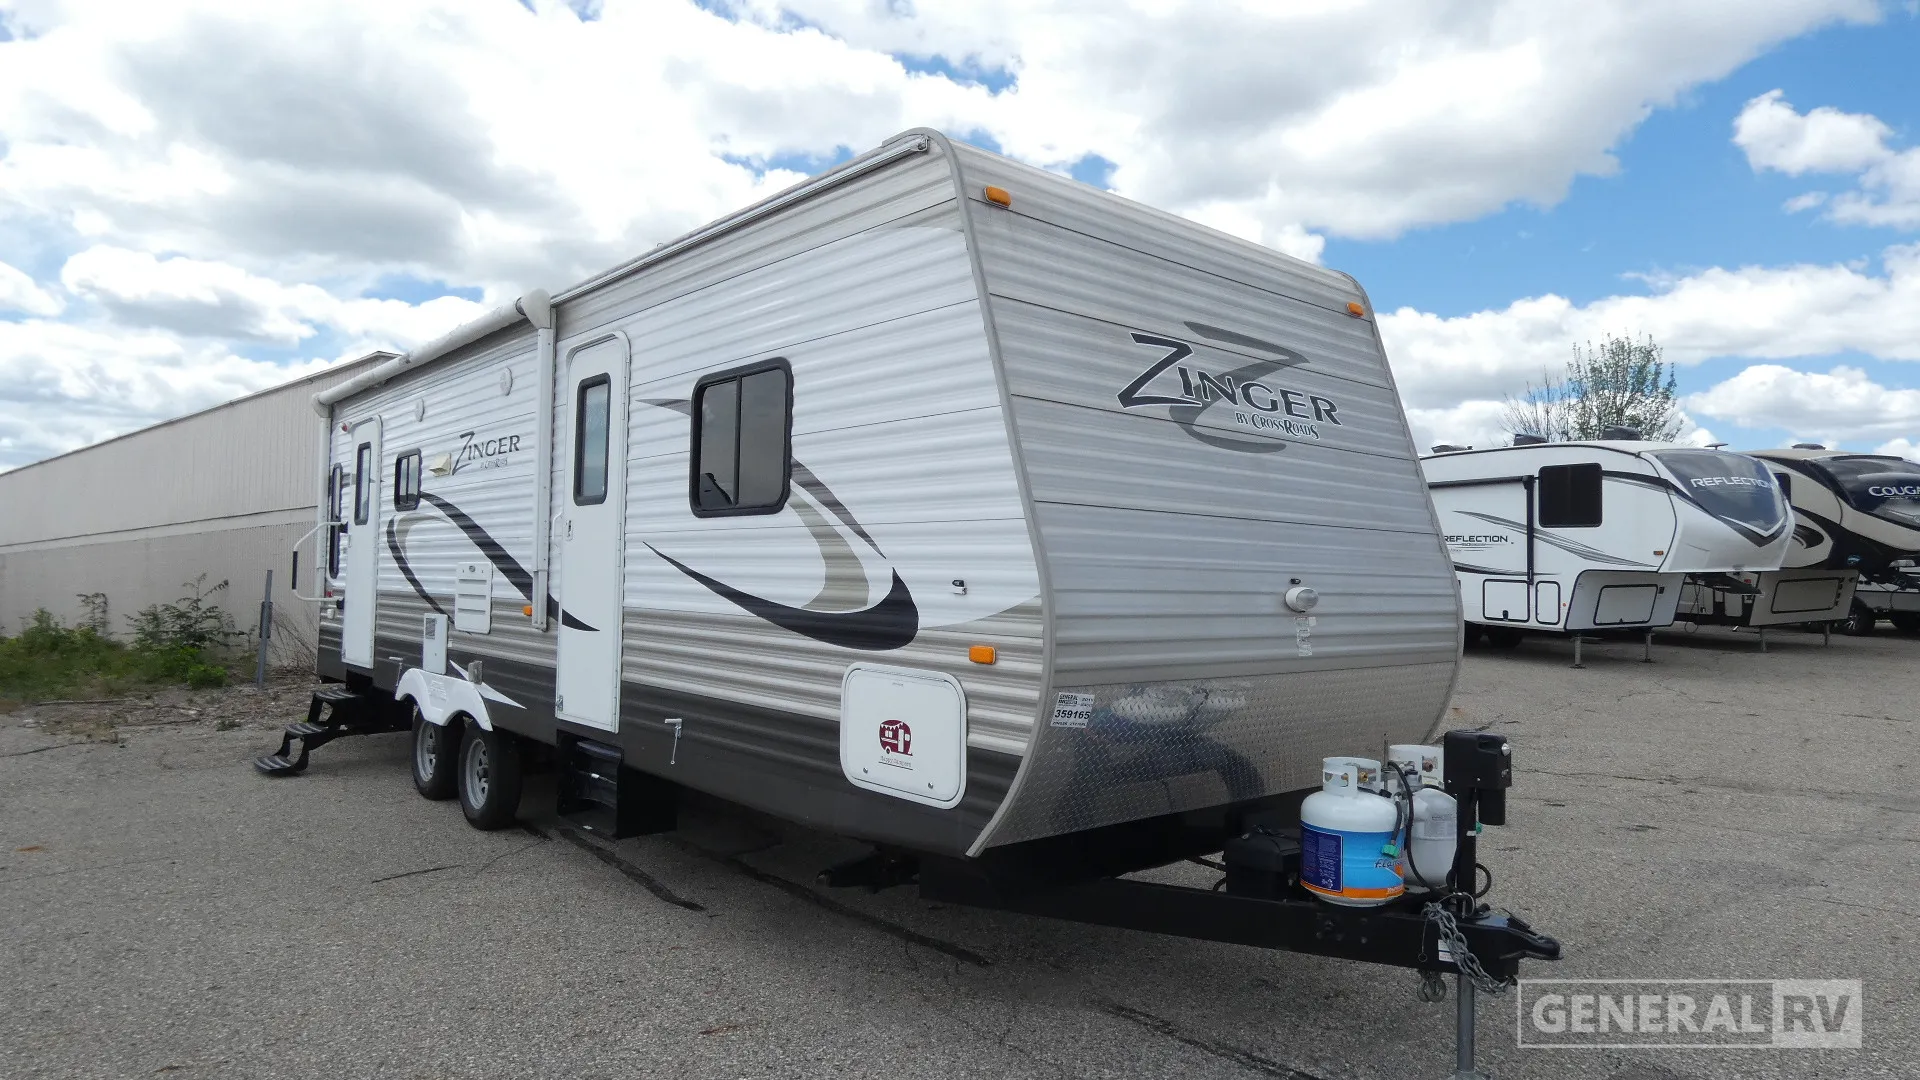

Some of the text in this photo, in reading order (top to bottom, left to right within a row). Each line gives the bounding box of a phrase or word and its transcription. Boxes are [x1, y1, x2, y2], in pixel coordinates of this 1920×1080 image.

[1116, 332, 1342, 426] ZINGER
[452, 431, 520, 475] ZINGER
[1868, 485, 1920, 497] COUG
[1444, 535, 1508, 543] REFLECTION
[1054, 709, 1090, 720] 359165
